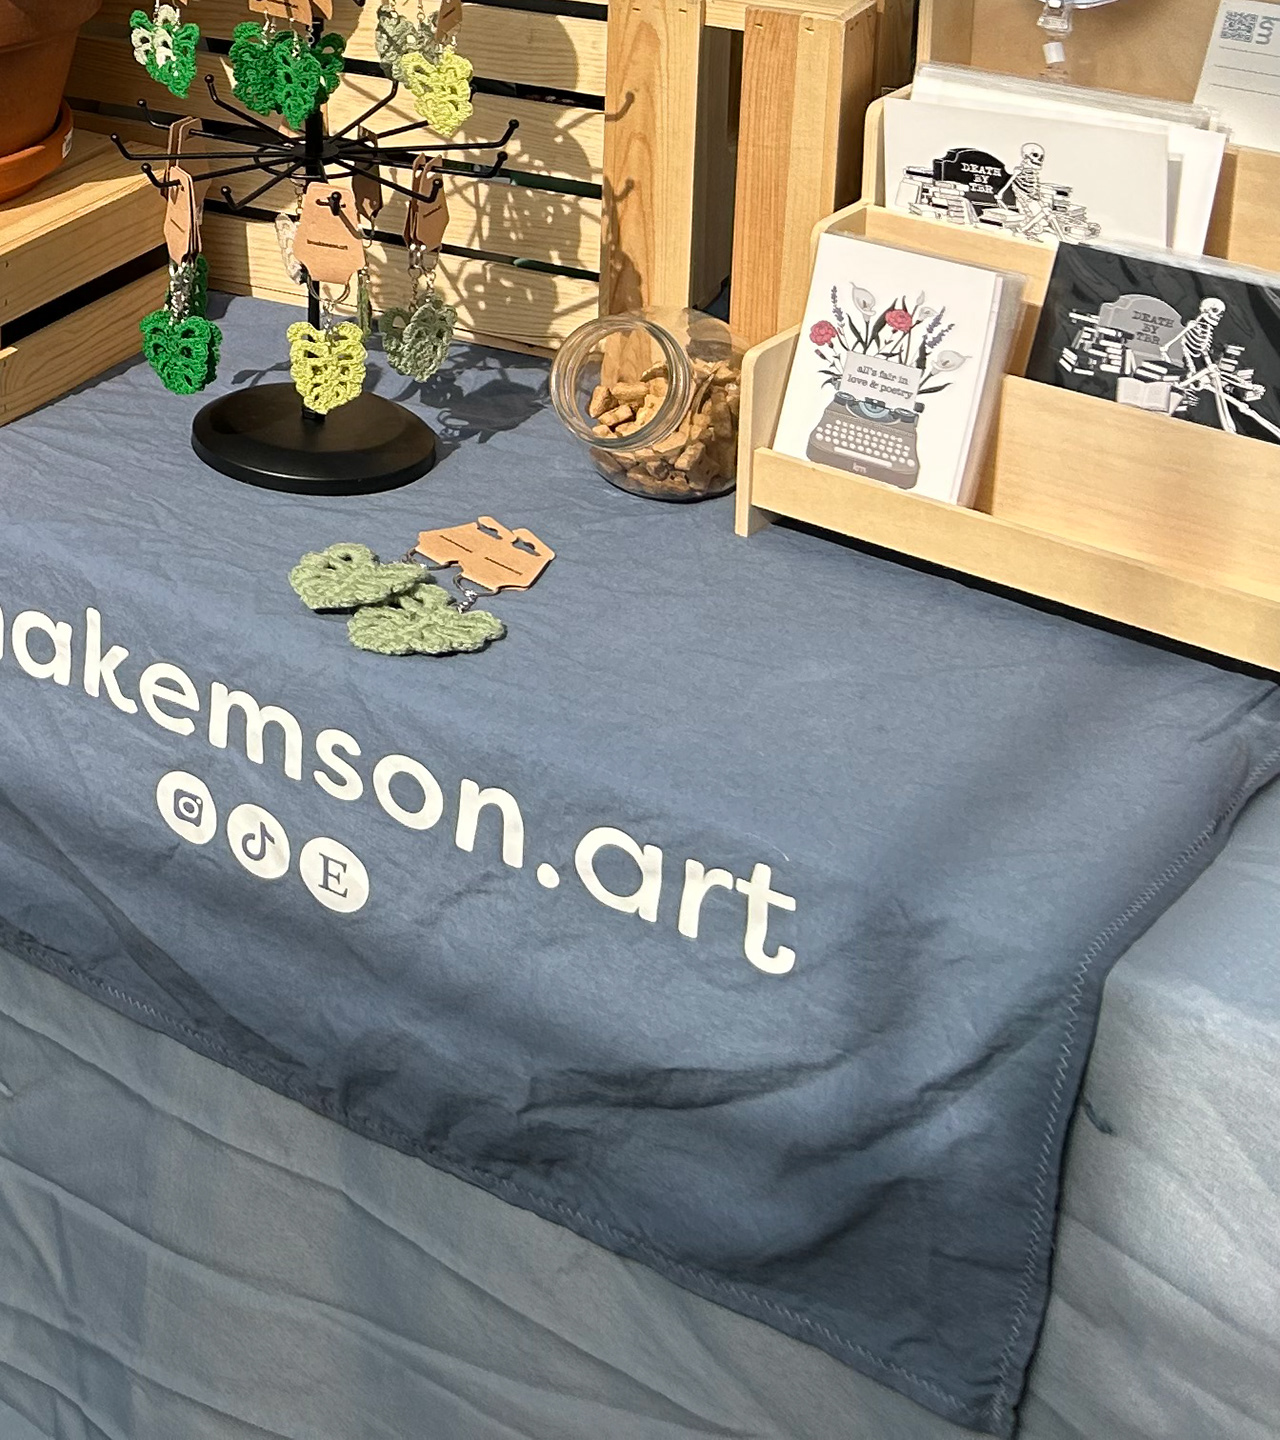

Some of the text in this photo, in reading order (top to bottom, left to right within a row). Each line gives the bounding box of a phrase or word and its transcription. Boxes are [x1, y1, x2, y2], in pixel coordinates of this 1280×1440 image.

[960, 162, 1002, 177] DEATH
[972, 173, 990, 184] BY
[968, 182, 994, 194] TBR
[1131, 310, 1176, 329] DEATH
[1141, 323, 1160, 334] BY
[1135, 331, 1160, 345] TBR
[856, 365, 909, 386] all's fair in
[846, 373, 914, 400] love & poetry
